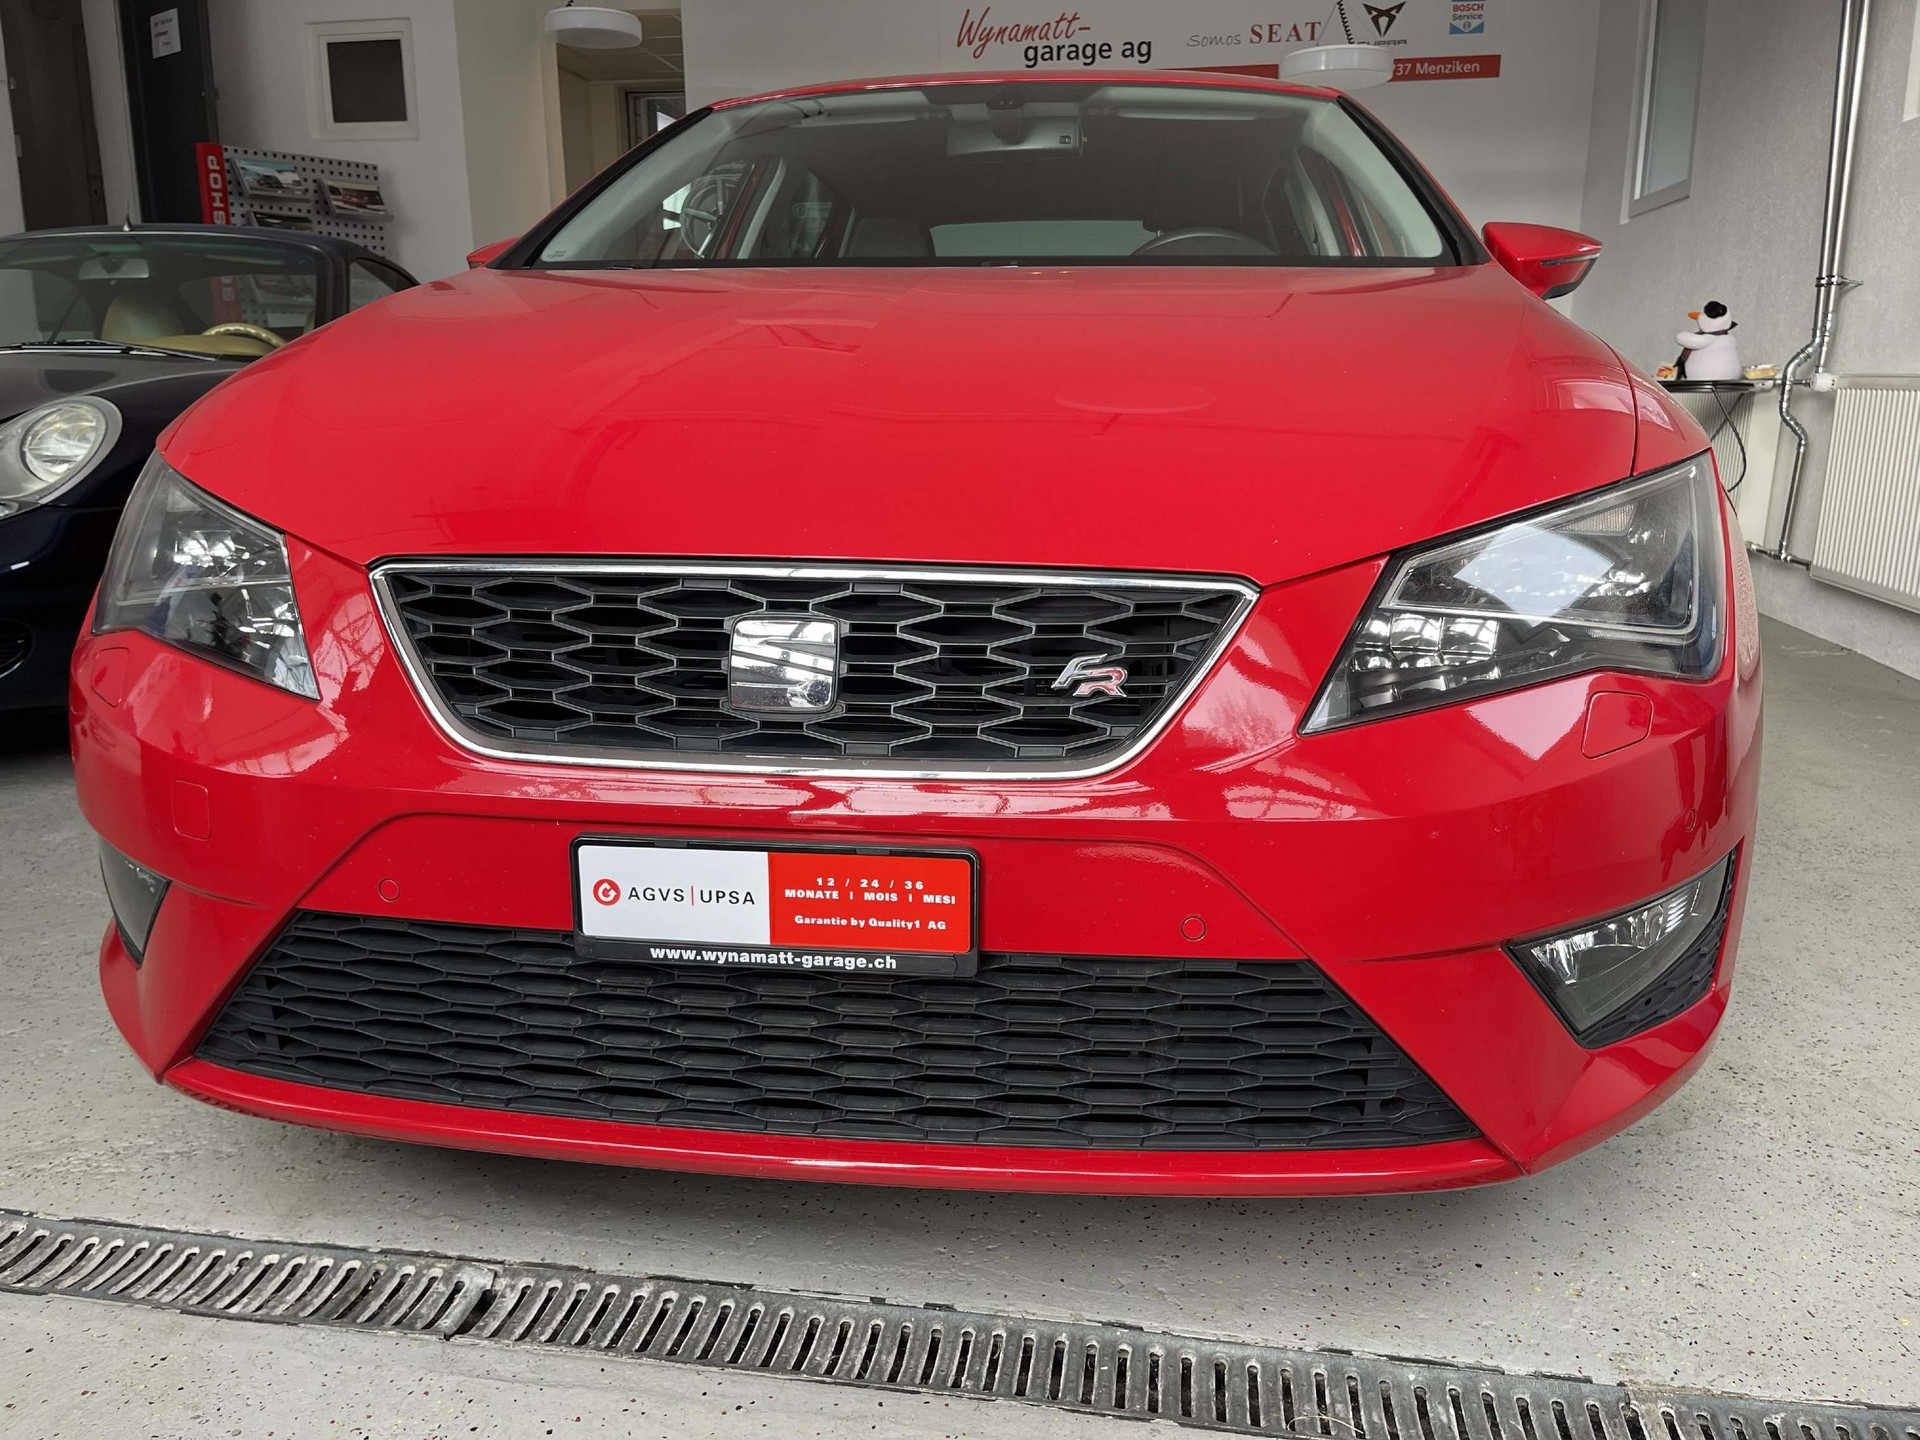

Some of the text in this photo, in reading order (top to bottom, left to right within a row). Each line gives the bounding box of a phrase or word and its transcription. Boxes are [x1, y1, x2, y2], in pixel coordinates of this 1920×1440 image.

[1452, 3, 1484, 12] BOSCH
[1452, 12, 1483, 21] Service
[956, 6, 1091, 59] Wynamatt-
[1186, 21, 1322, 47] Somos SEAT
[1023, 40, 1152, 68] garage ag
[1415, 61, 1480, 75] Menziken
[207, 155, 226, 226] SHOP
[1051, 653, 1128, 697] FR
[816, 877, 835, 887] 12
[860, 879, 880, 888] 24
[904, 881, 924, 890] 36
[628, 887, 755, 905] AGVS UPSA
[784, 889, 840, 900] MONATE
[864, 892, 899, 902] MOIS
[923, 894, 956, 904] MESI
[794, 915, 947, 930] Garantie by Quality1 AG
[650, 947, 897, 970] www.wynamatt-garage.ch
